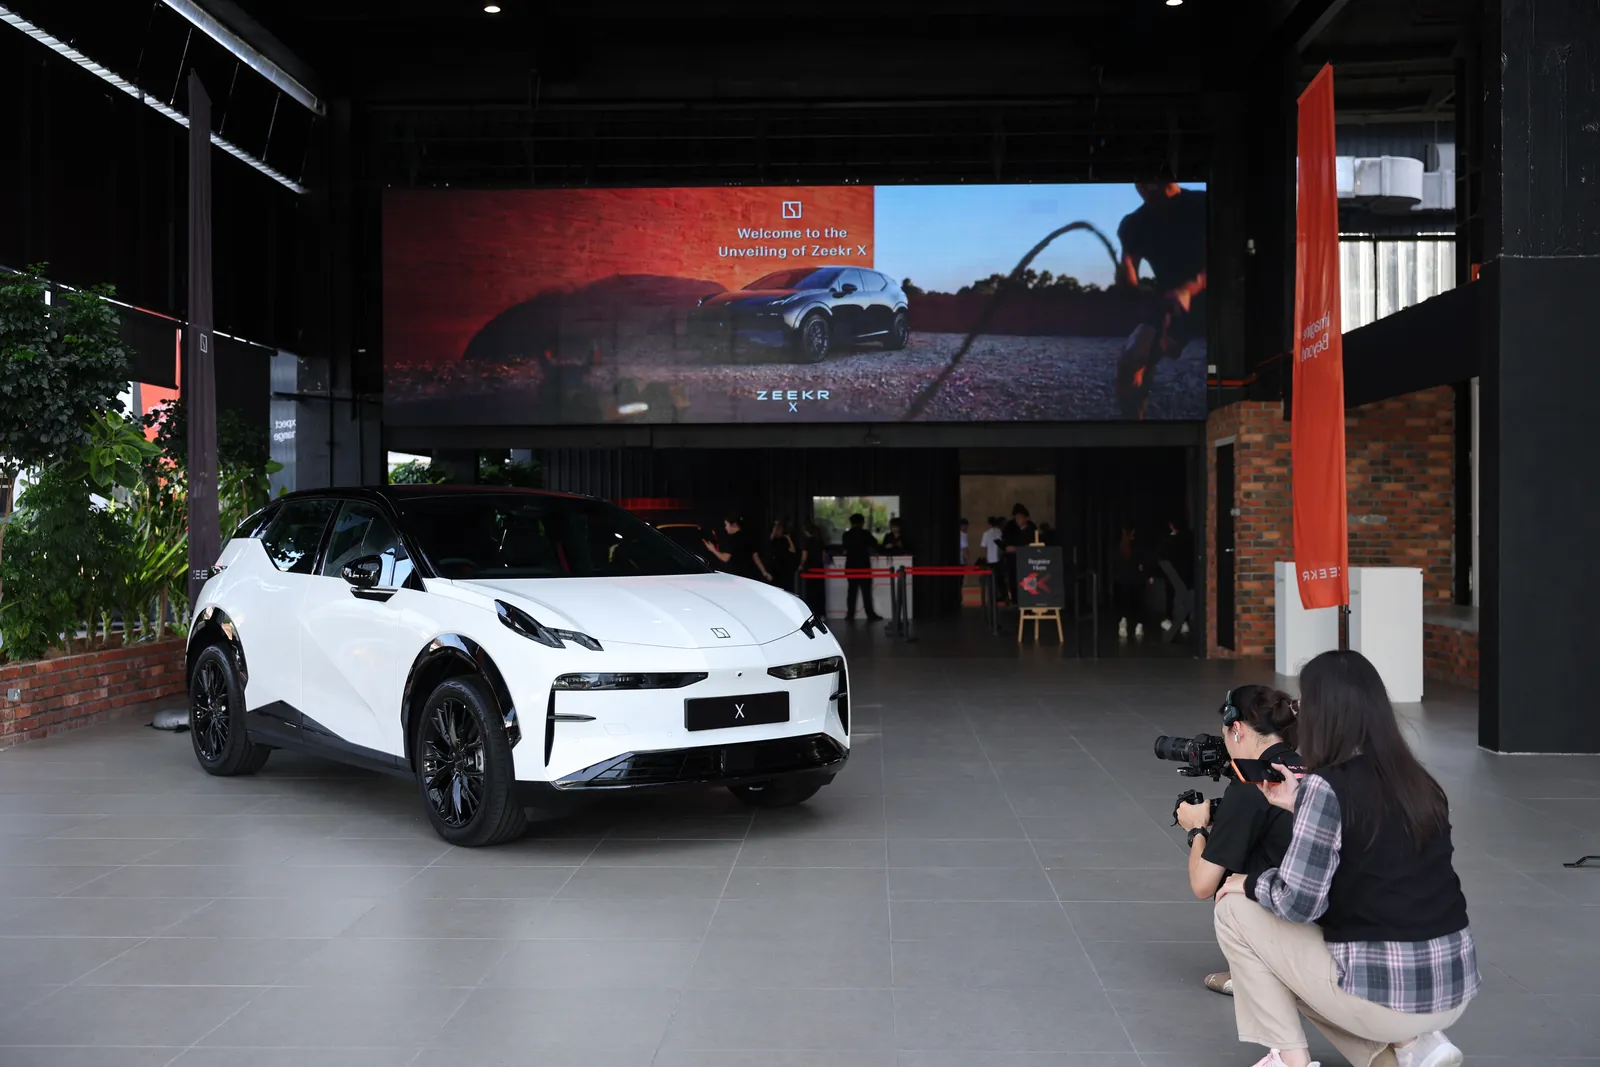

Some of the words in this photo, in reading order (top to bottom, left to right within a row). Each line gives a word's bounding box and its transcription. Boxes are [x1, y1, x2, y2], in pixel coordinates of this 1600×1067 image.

[737, 228, 802, 239] Welcome
[805, 228, 820, 239] to
[824, 227, 848, 238] the
[718, 246, 787, 259] Unveiling
[791, 246, 807, 257] of
[811, 245, 853, 257] Zeekr
[857, 245, 867, 256] X
[756, 390, 830, 400] ZEEKR
[788, 402, 798, 413] X
[735, 704, 745, 718] X
